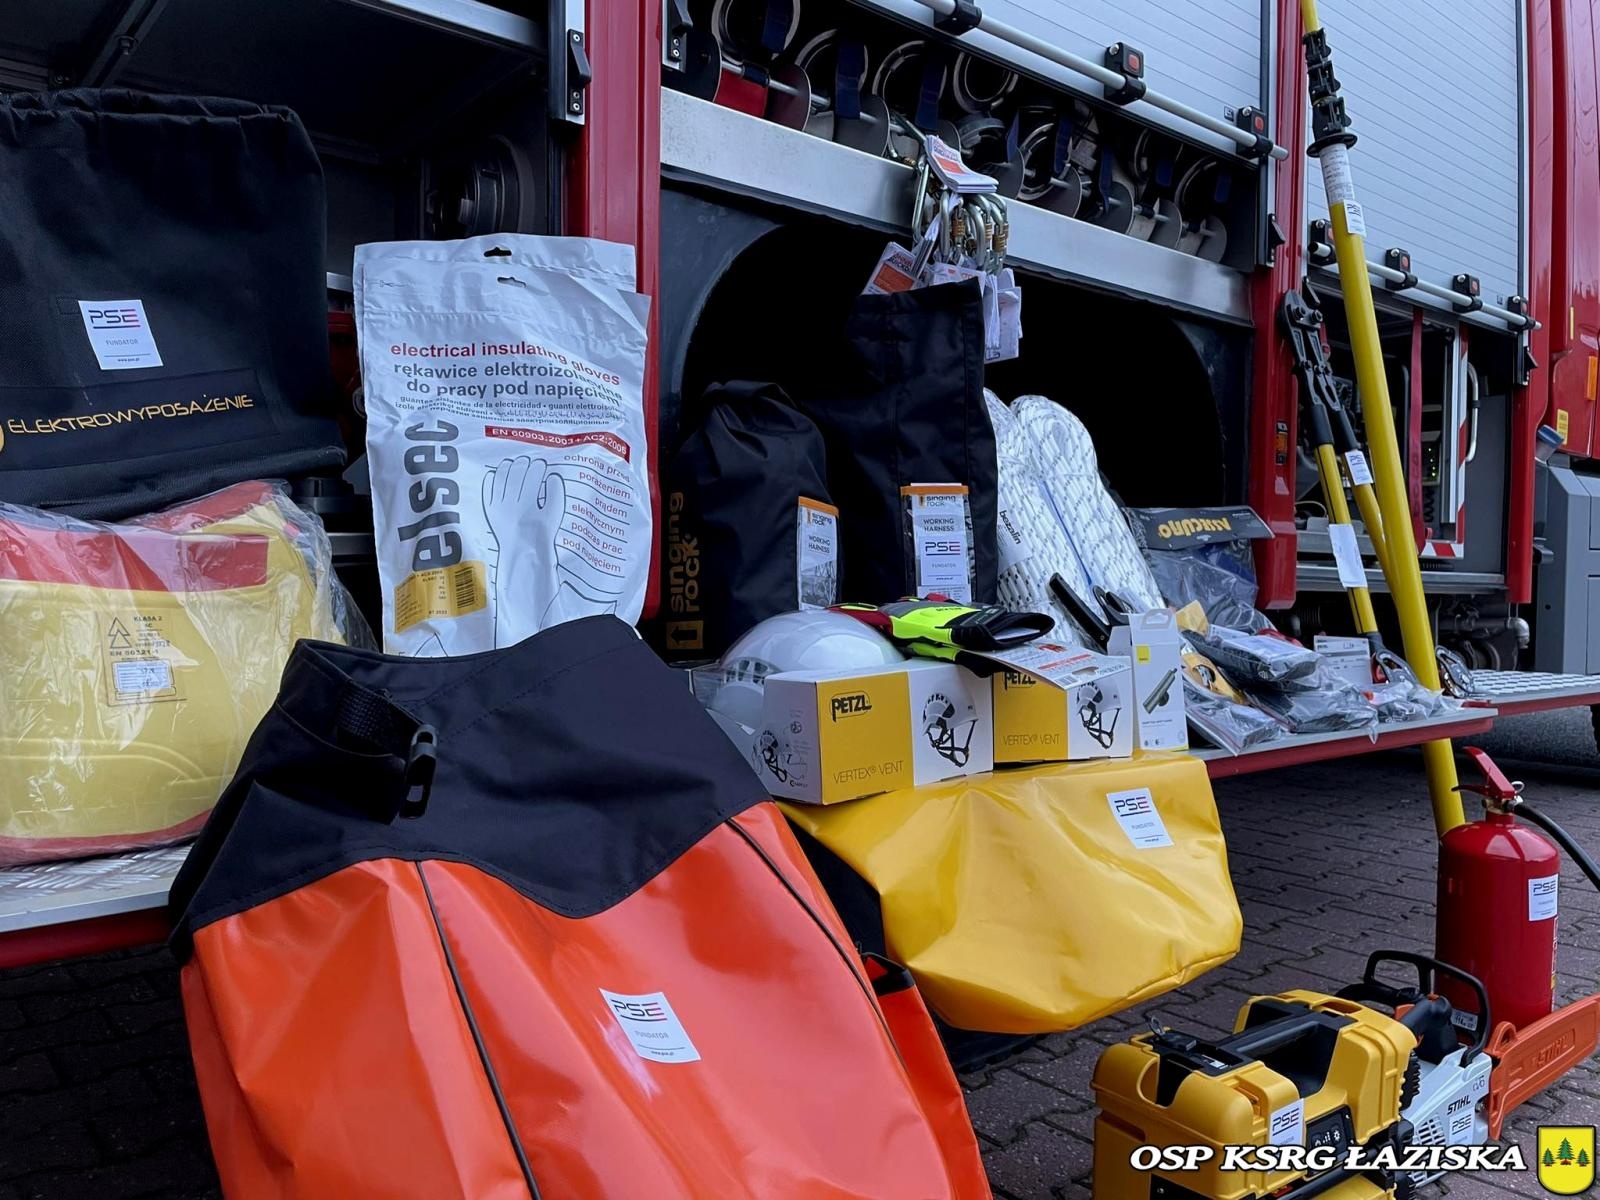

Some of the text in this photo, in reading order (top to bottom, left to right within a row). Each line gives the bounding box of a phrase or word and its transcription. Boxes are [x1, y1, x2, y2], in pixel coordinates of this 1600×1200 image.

[88, 309, 139, 324] PSE
[105, 338, 138, 346] FUNDATOR
[390, 341, 620, 386] electrical insulating gloves
[394, 361, 622, 401] rękawice elektroizolacyjne
[407, 379, 620, 406] do pracy pod napięciem
[8, 394, 254, 434] ELEKTROWYPOSAŻENIE
[494, 401, 542, 409] electricidad
[548, 402, 574, 410] guanti
[492, 428, 508, 436] EN
[564, 454, 605, 470] ochrona
[397, 419, 463, 571] elsec
[579, 471, 631, 499] porażeniem
[595, 497, 628, 518] prądem
[571, 503, 625, 536] elektrycznym
[571, 521, 623, 555] podczas prac
[808, 535, 830, 546] WORKING
[808, 543, 830, 554] HARNESS
[925, 541, 960, 552] PSE
[562, 537, 621, 573] pod napięciem
[668, 491, 684, 613] singing
[682, 534, 700, 613] rock
[831, 693, 873, 723] PETZL
[1039, 733, 1061, 745] VENT
[878, 759, 904, 777] VENT
[1114, 796, 1150, 813] PSE
[1533, 880, 1556, 893] PSE
[610, 999, 665, 1017] PSE
[1446, 1094, 1471, 1116] STIHL
[1272, 1107, 1300, 1132] PSE
[1451, 1113, 1472, 1132] PSE
